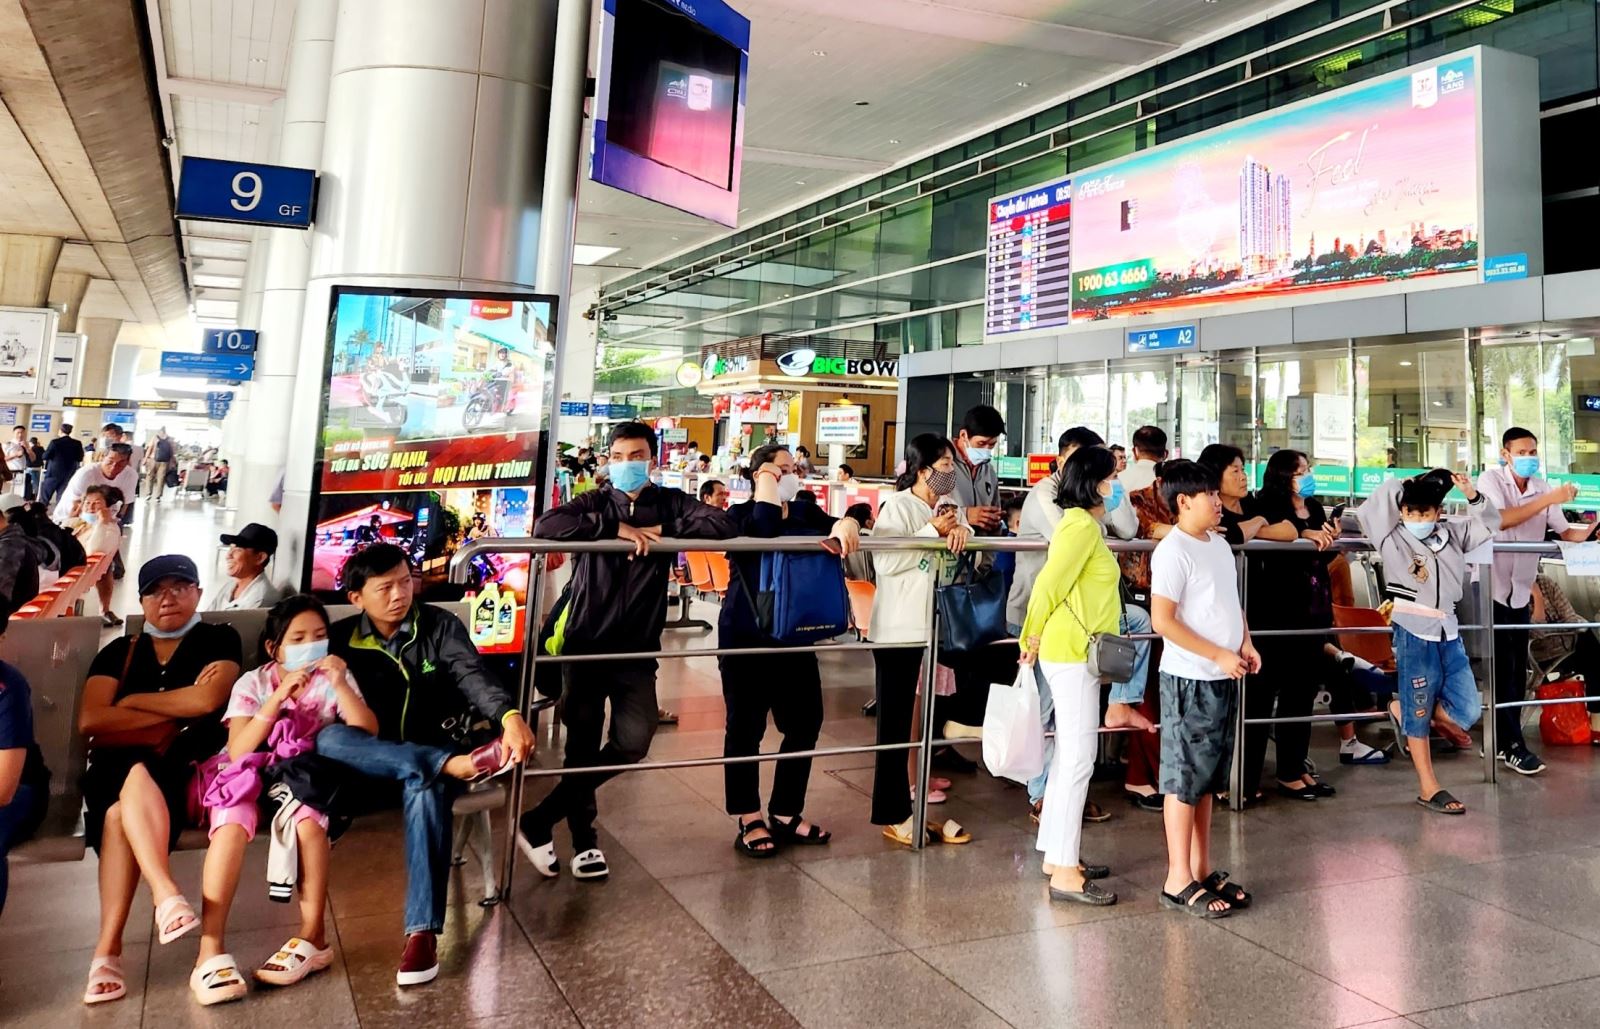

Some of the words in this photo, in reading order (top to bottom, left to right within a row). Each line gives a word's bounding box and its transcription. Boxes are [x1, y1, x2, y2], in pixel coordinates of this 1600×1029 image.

[230, 171, 263, 212] 9
[278, 204, 302, 217] GF
[1079, 273, 1102, 292] 1900
[1104, 270, 1118, 287] 63
[1121, 265, 1148, 285] 6666
[213, 331, 242, 350] 10
[1177, 329, 1192, 345] A2
[361, 451, 390, 471] SỨC
[390, 450, 429, 471] MẠNH,
[398, 470, 414, 486] TỐI
[432, 466, 458, 485] MỌI
[458, 462, 493, 482] HÀNH
[494, 459, 532, 479] TRÌNH
[1362, 473, 1381, 483] Grab
